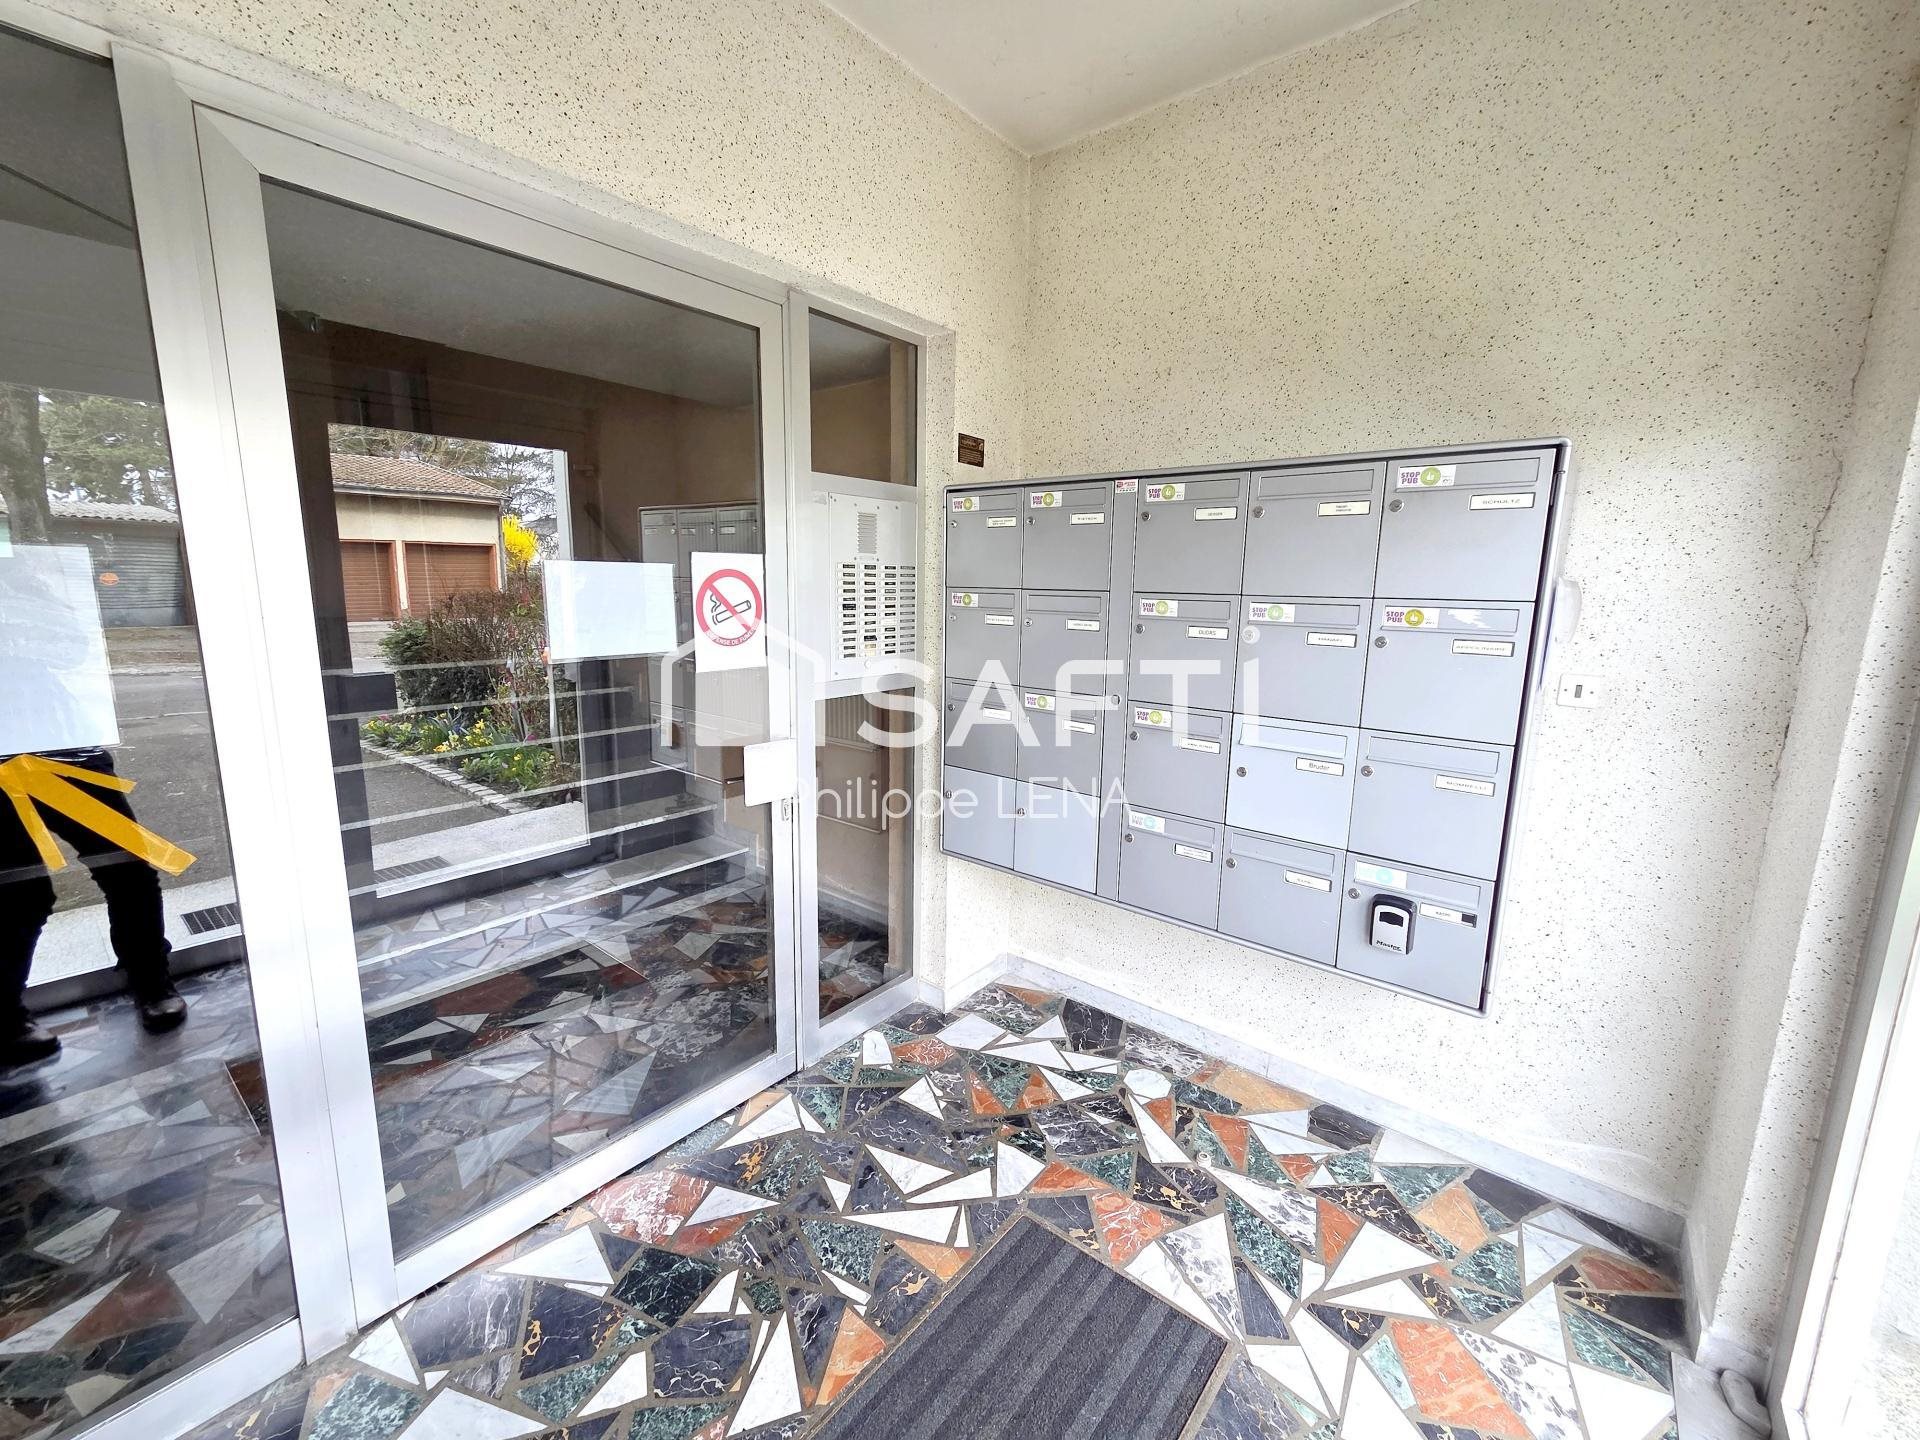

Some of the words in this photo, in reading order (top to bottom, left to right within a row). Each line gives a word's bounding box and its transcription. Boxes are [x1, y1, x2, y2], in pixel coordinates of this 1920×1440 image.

[1400, 471, 1420, 479] STOP
[1401, 477, 1419, 485] PUB
[1308, 762, 1330, 772] Bruder
[1375, 939, 1402, 952] Master
